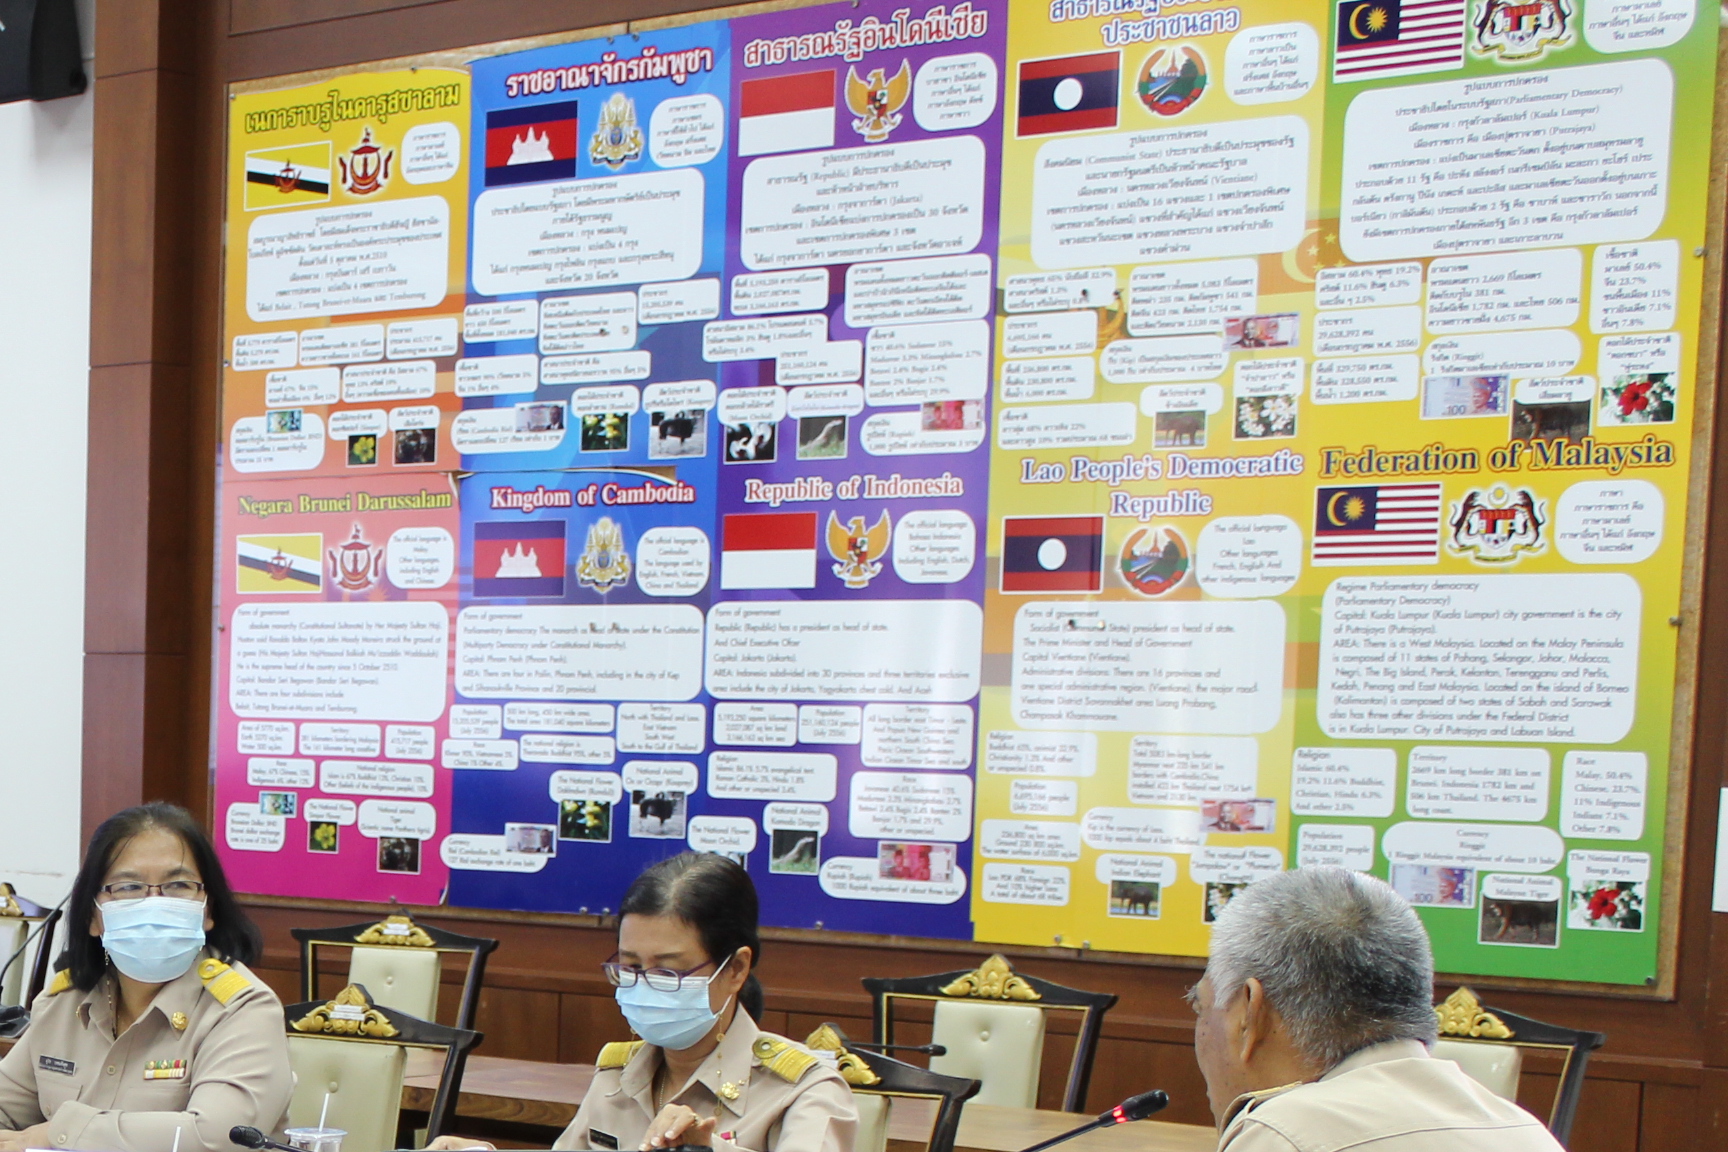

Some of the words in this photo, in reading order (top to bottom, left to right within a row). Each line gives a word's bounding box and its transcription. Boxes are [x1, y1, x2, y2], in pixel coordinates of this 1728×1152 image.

[1101, 8, 1240, 45] ประชาชนลาว
[506, 46, 713, 97] ราชอาณาจักรกัมพูชา
[1021, 457, 1065, 483] Lao
[1070, 453, 1162, 486] People's
[1168, 449, 1304, 480] Democratic
[1320, 446, 1480, 478] Federation
[1490, 443, 1521, 473] of
[1530, 437, 1675, 473] Malaysia
[491, 486, 571, 512] Kingdom
[577, 484, 597, 507] of
[602, 481, 696, 506] Cambodia
[745, 477, 833, 506] Republic
[838, 475, 860, 499] of
[864, 472, 964, 497] Indonesia
[238, 496, 293, 518] Negara
[298, 493, 352, 514] Brunei
[358, 489, 452, 512] Darussalam
[1110, 491, 1212, 522] Republic
[1431, 582, 1478, 591] democracy
[1370, 609, 1394, 619] Kuala
[1398, 610, 1428, 620] Lumpur
[1432, 608, 1461, 619] (Kuala
[1464, 610, 1499, 620] Lumpur)
[1503, 610, 1518, 620] city
[1521, 610, 1574, 620] government
[1588, 608, 1602, 618] the
[1606, 610, 1621, 620] city
[1334, 624, 1342, 634] of
[1094, 637, 1109, 646] and
[1144, 638, 1193, 647] Government
[1363, 638, 1386, 647] There
[1409, 639, 1431, 647] West
[1479, 638, 1513, 647] Located
[1531, 637, 1545, 647] the
[1548, 637, 1576, 650] Malay
[1580, 638, 1624, 648] Peninsula
[1342, 652, 1385, 663] composed
[1388, 652, 1396, 662] of
[1441, 652, 1450, 662] of
[1297, 750, 1330, 761] Religion
[1587, 854, 1620, 862] National
